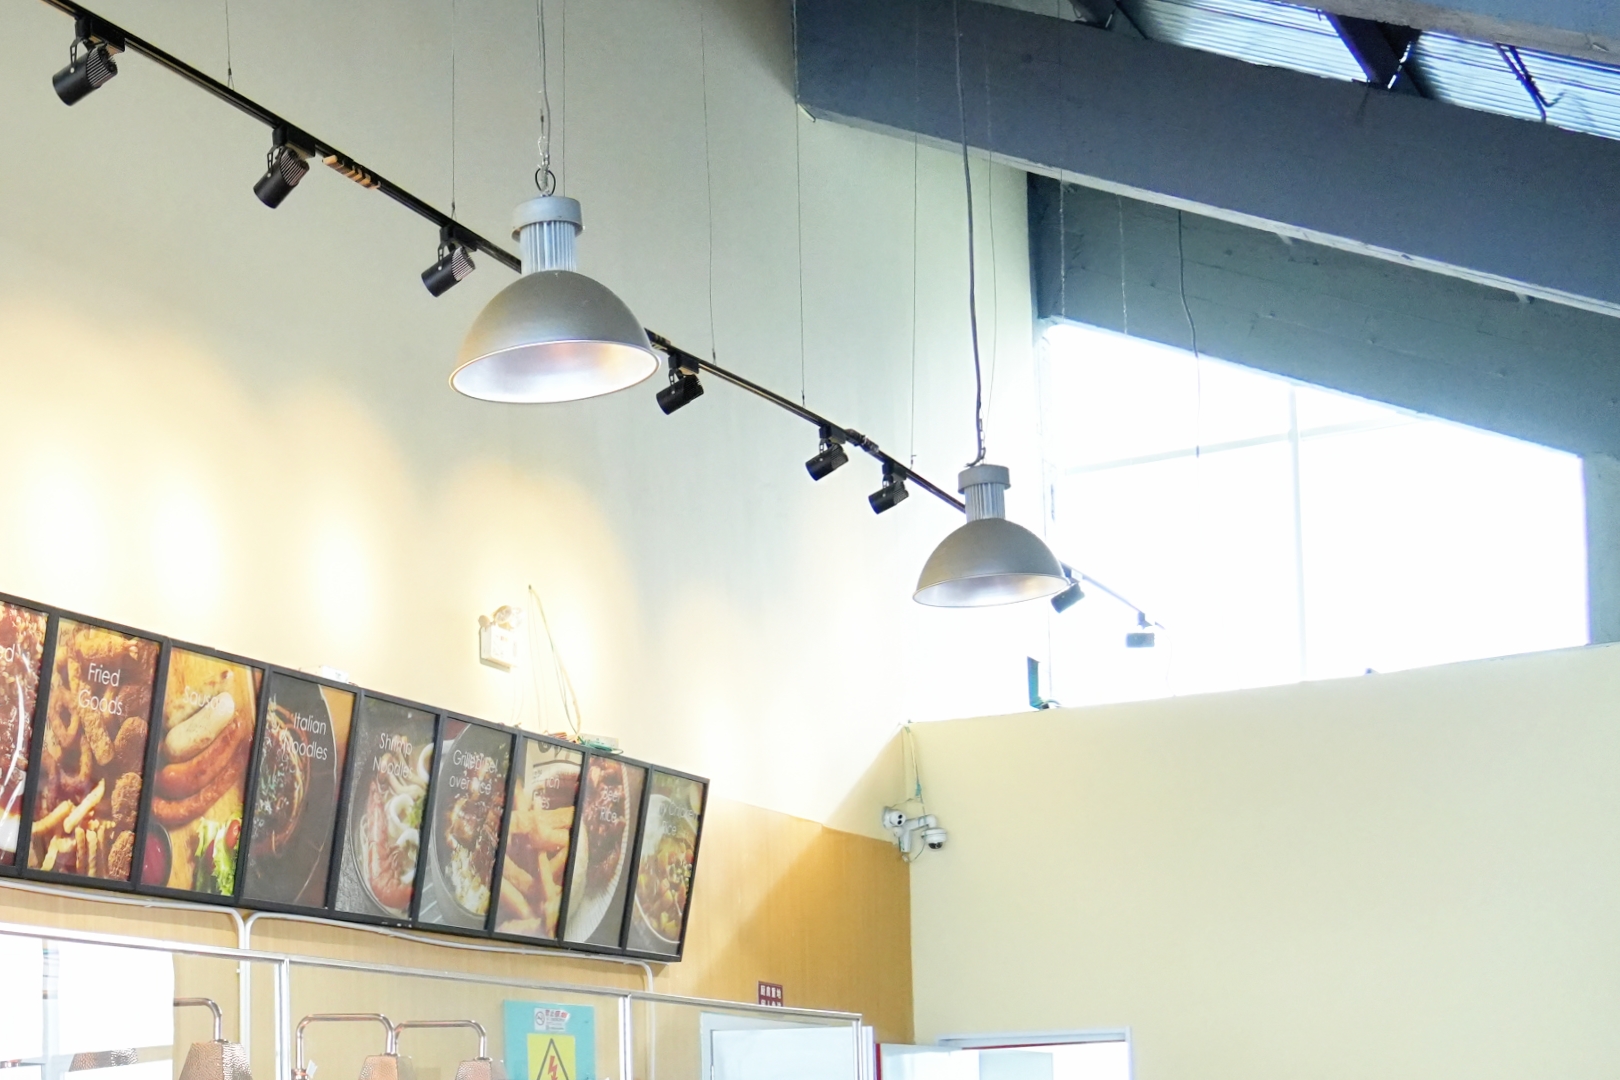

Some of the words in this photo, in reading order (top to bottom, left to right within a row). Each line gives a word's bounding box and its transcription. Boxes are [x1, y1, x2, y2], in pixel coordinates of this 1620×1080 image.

[87, 662, 121, 687] Fried
[78, 688, 123, 716] Goods
[293, 712, 327, 735] Italian
[283, 736, 328, 761] Noodles
[378, 732, 413, 756] Shrimp
[372, 755, 414, 779] Noodles
[448, 775, 471, 791] over
